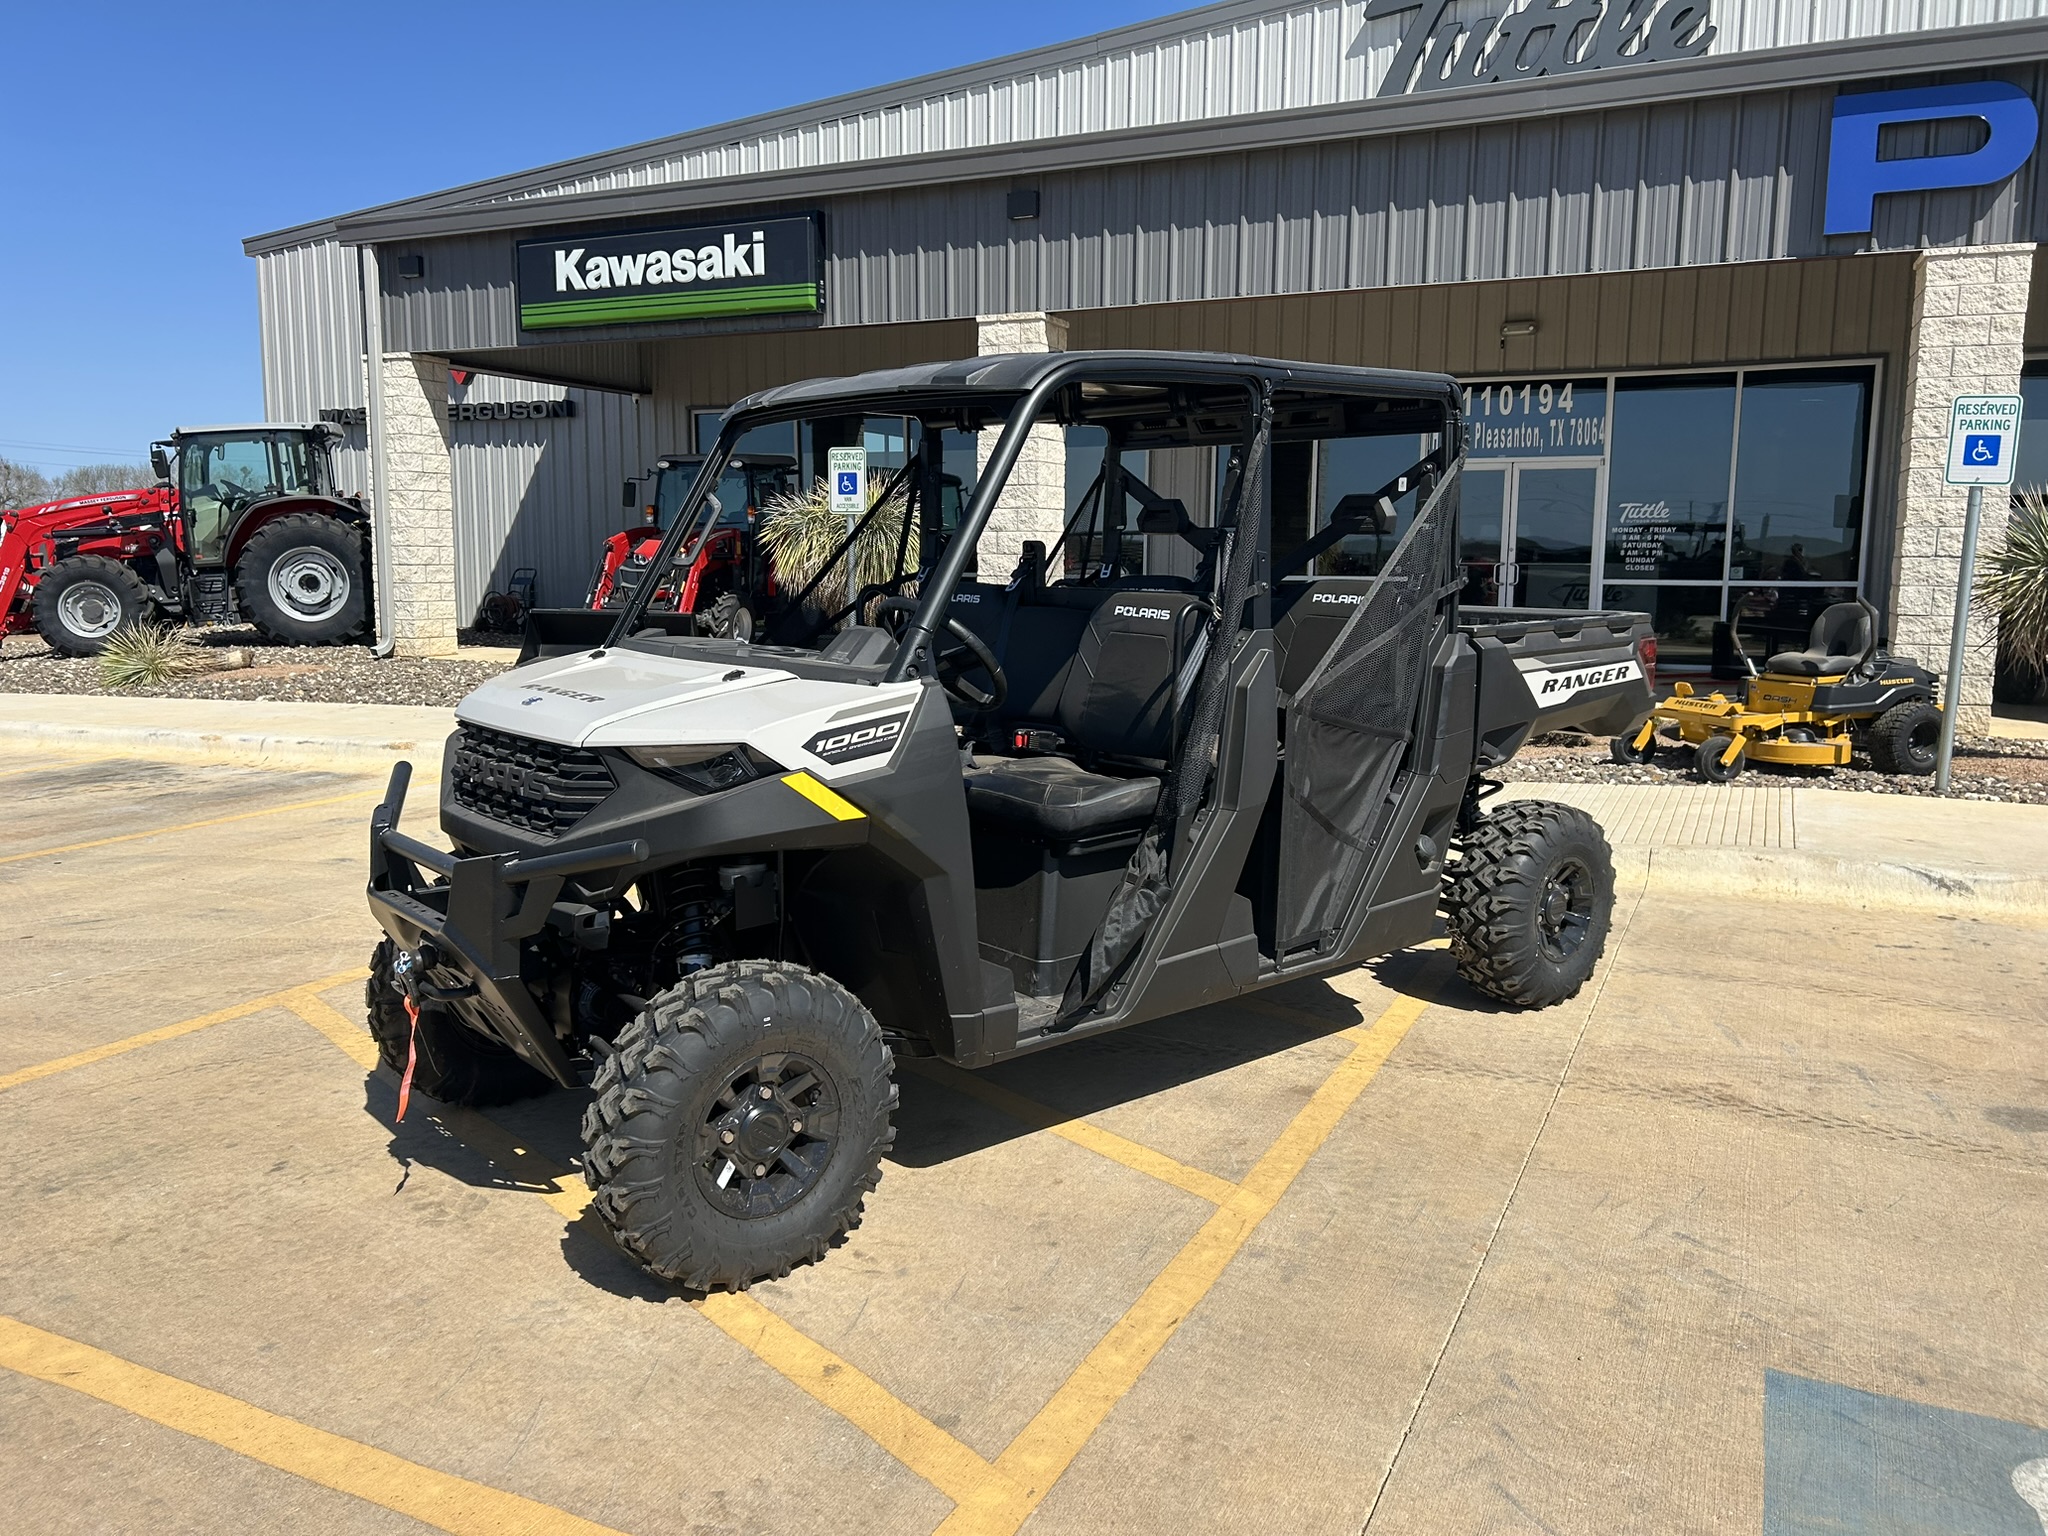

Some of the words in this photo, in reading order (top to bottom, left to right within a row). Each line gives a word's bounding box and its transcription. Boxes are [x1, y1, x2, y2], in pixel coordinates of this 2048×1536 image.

[1364, 0, 1717, 98] Tuttle
[1824, 80, 2038, 235] P
[555, 230, 766, 292] Kawasaki
[319, 407, 367, 425] MAS
[448, 400, 576, 421] ERGUSON
[1958, 403, 2017, 415] RESERVED
[1474, 421, 1544, 453] Pleasanton,
[1550, 419, 1565, 447] TX
[1570, 416, 1605, 446] 78064
[1959, 419, 2011, 431] PARKING
[831, 452, 864, 461] RESERVED
[833, 462, 862, 471] PARKING
[1619, 500, 1671, 524] Tuttle
[951, 594, 981, 604] LARIS
[1312, 593, 1365, 605] POLARI
[1560, 582, 1624, 607] Tule
[1114, 605, 1171, 620] POLARIS
[1541, 666, 1630, 695] RANGER
[1879, 677, 1915, 686] HUSTLER
[520, 683, 606, 703] RANGER
[1763, 694, 1798, 704] DASH
[1674, 699, 1718, 710] HUSTLER
[815, 721, 901, 753] 1000
[455, 749, 550, 801] POLARIS
